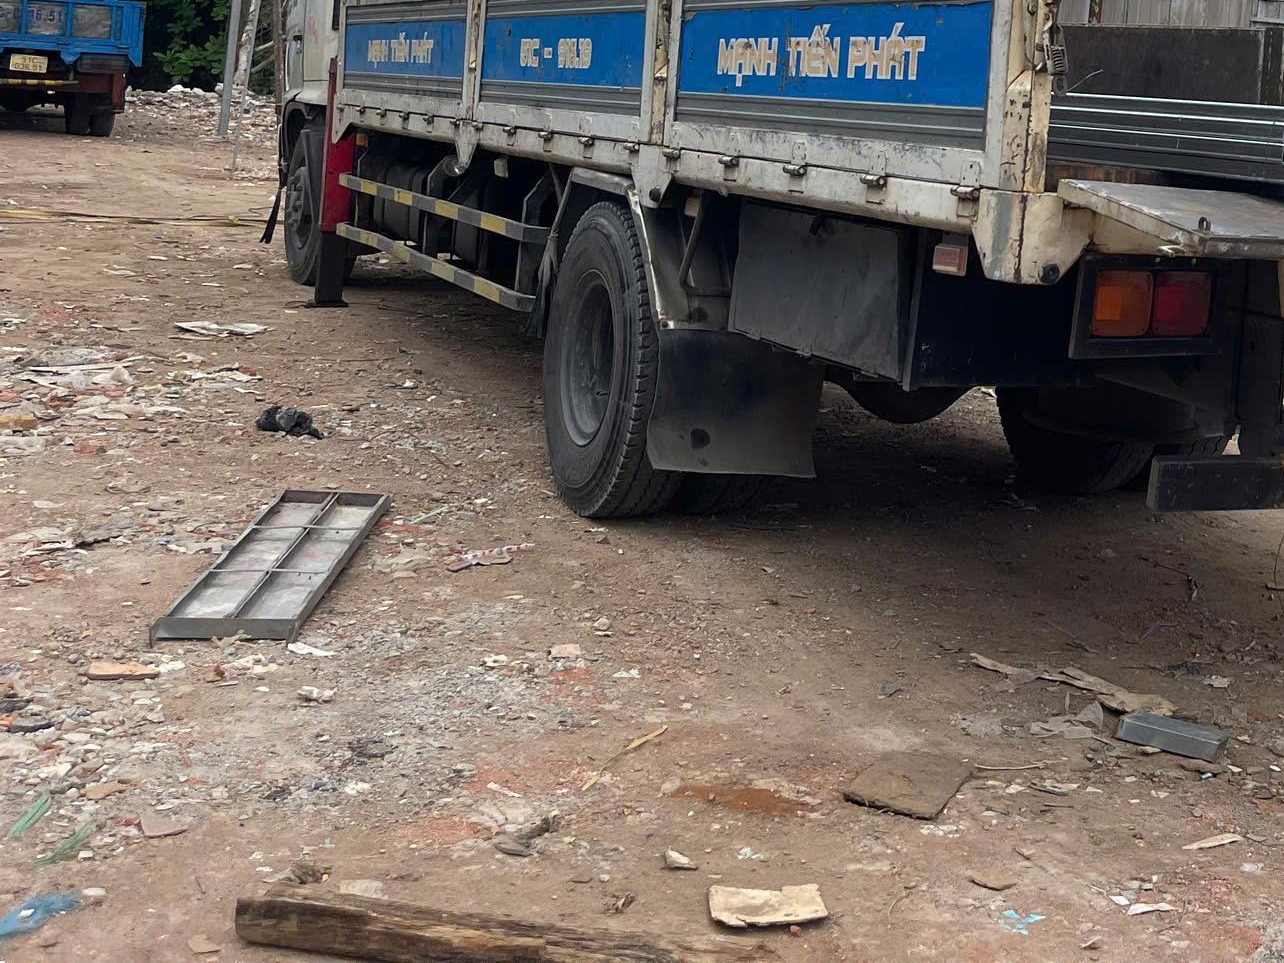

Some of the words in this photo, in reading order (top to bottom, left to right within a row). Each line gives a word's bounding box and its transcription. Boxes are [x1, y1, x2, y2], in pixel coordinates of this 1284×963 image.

[717, 37, 779, 87] MẠNH
[788, 24, 841, 78] TIẾN
[846, 22, 926, 80] PHÁT
